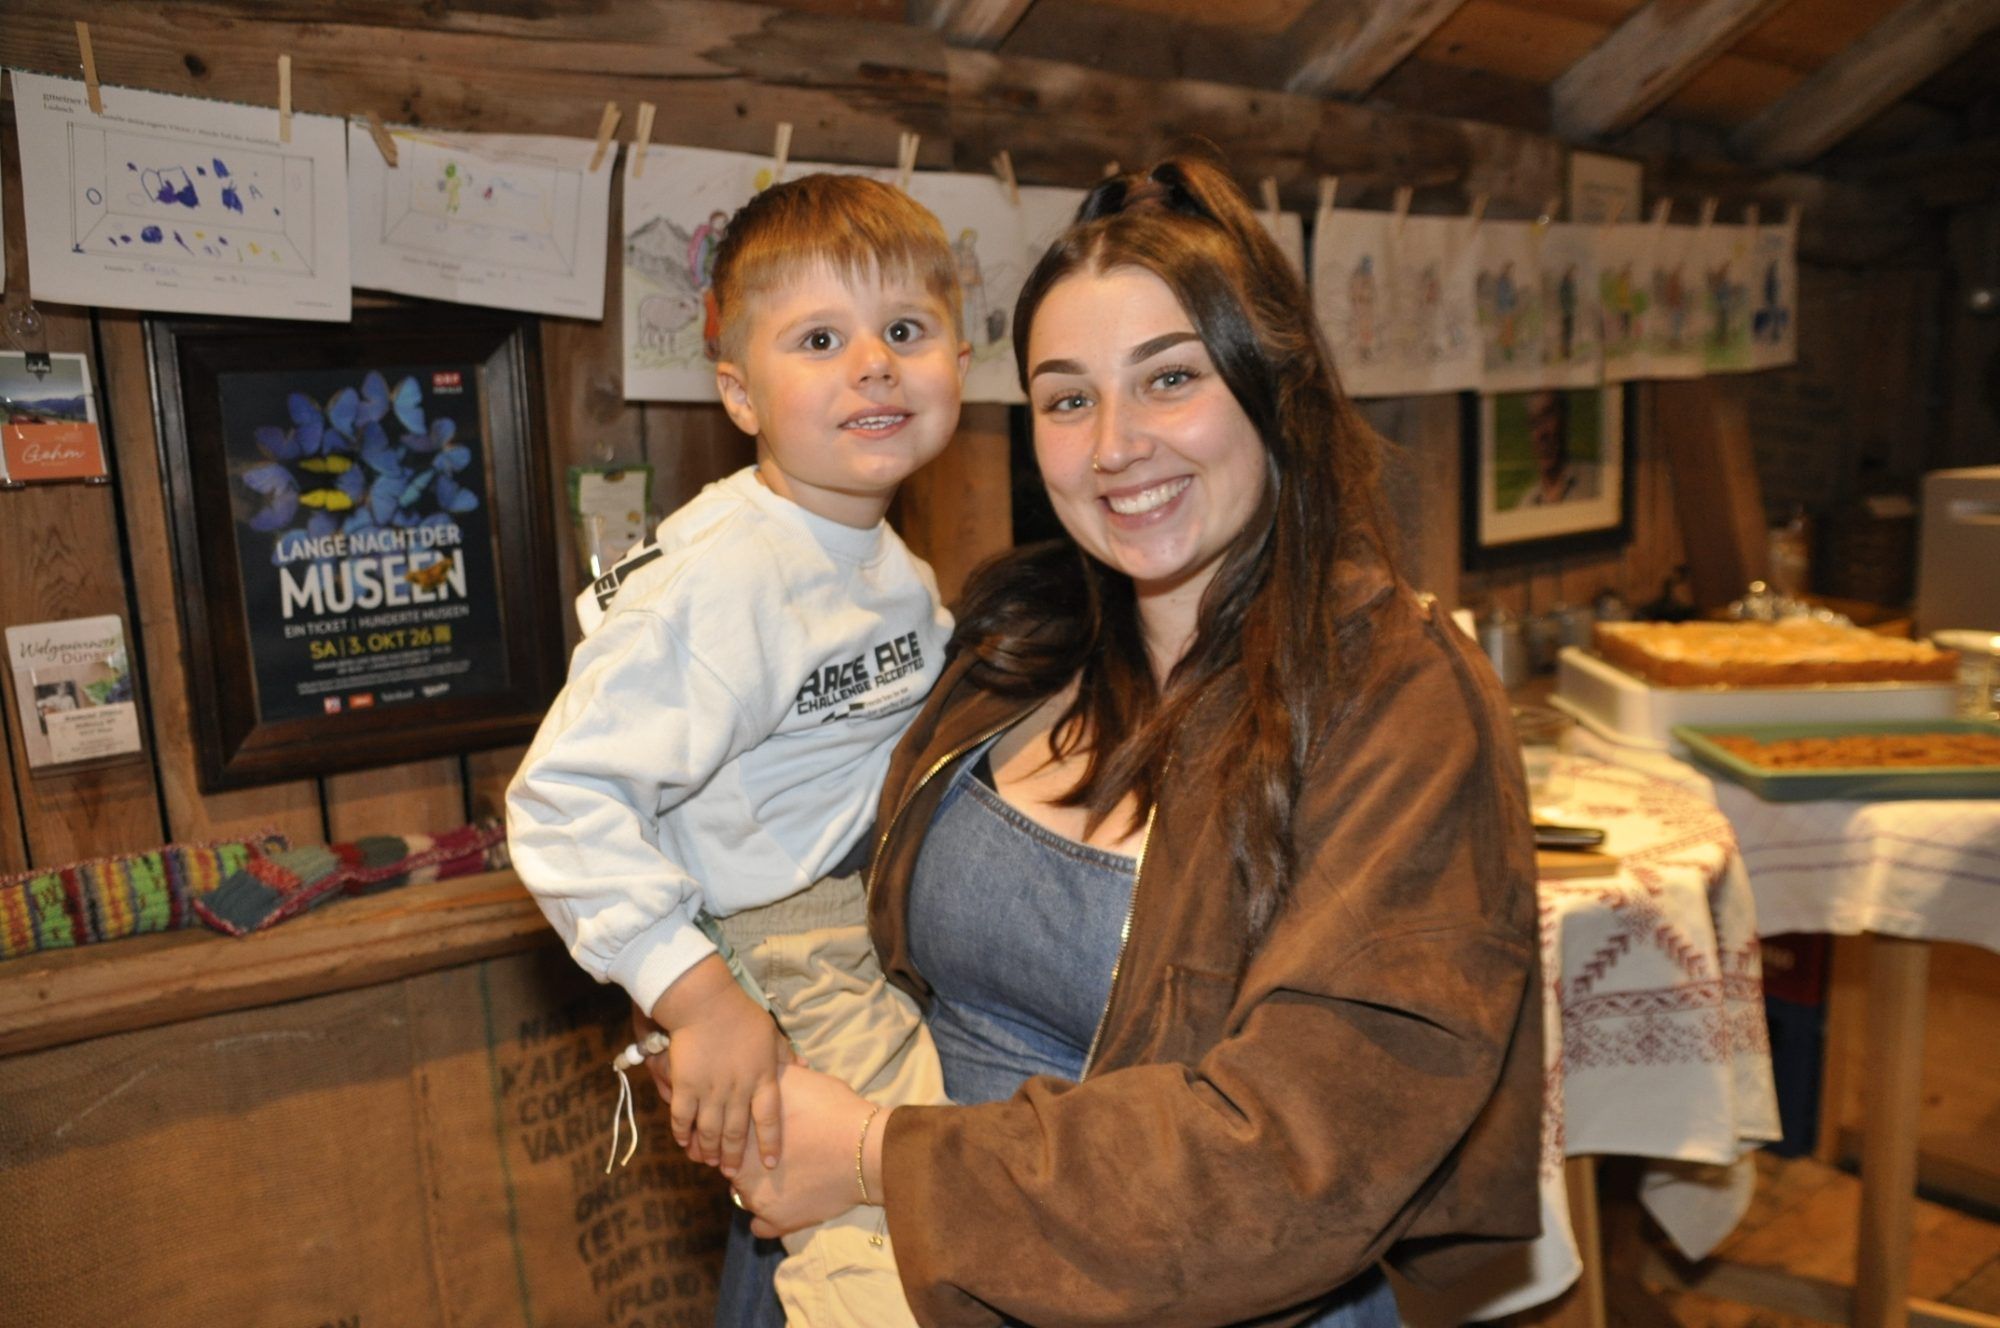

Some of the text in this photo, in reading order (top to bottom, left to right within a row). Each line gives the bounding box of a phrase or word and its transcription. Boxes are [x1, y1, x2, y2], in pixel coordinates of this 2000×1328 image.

[276, 523, 461, 563] LANGE NACHT DER
[279, 547, 468, 619] MUSEEN
[284, 624, 306, 639] EIN
[307, 618, 347, 635] TICKET
[358, 610, 420, 629] HUNDERTE
[422, 603, 470, 621] MUSEEN
[309, 640, 338, 660] SA
[368, 630, 405, 652] OKT
[874, 630, 920, 673] ACE
[797, 680, 872, 715] CHALLENGE
[874, 657, 925, 688] ACCEPTED
